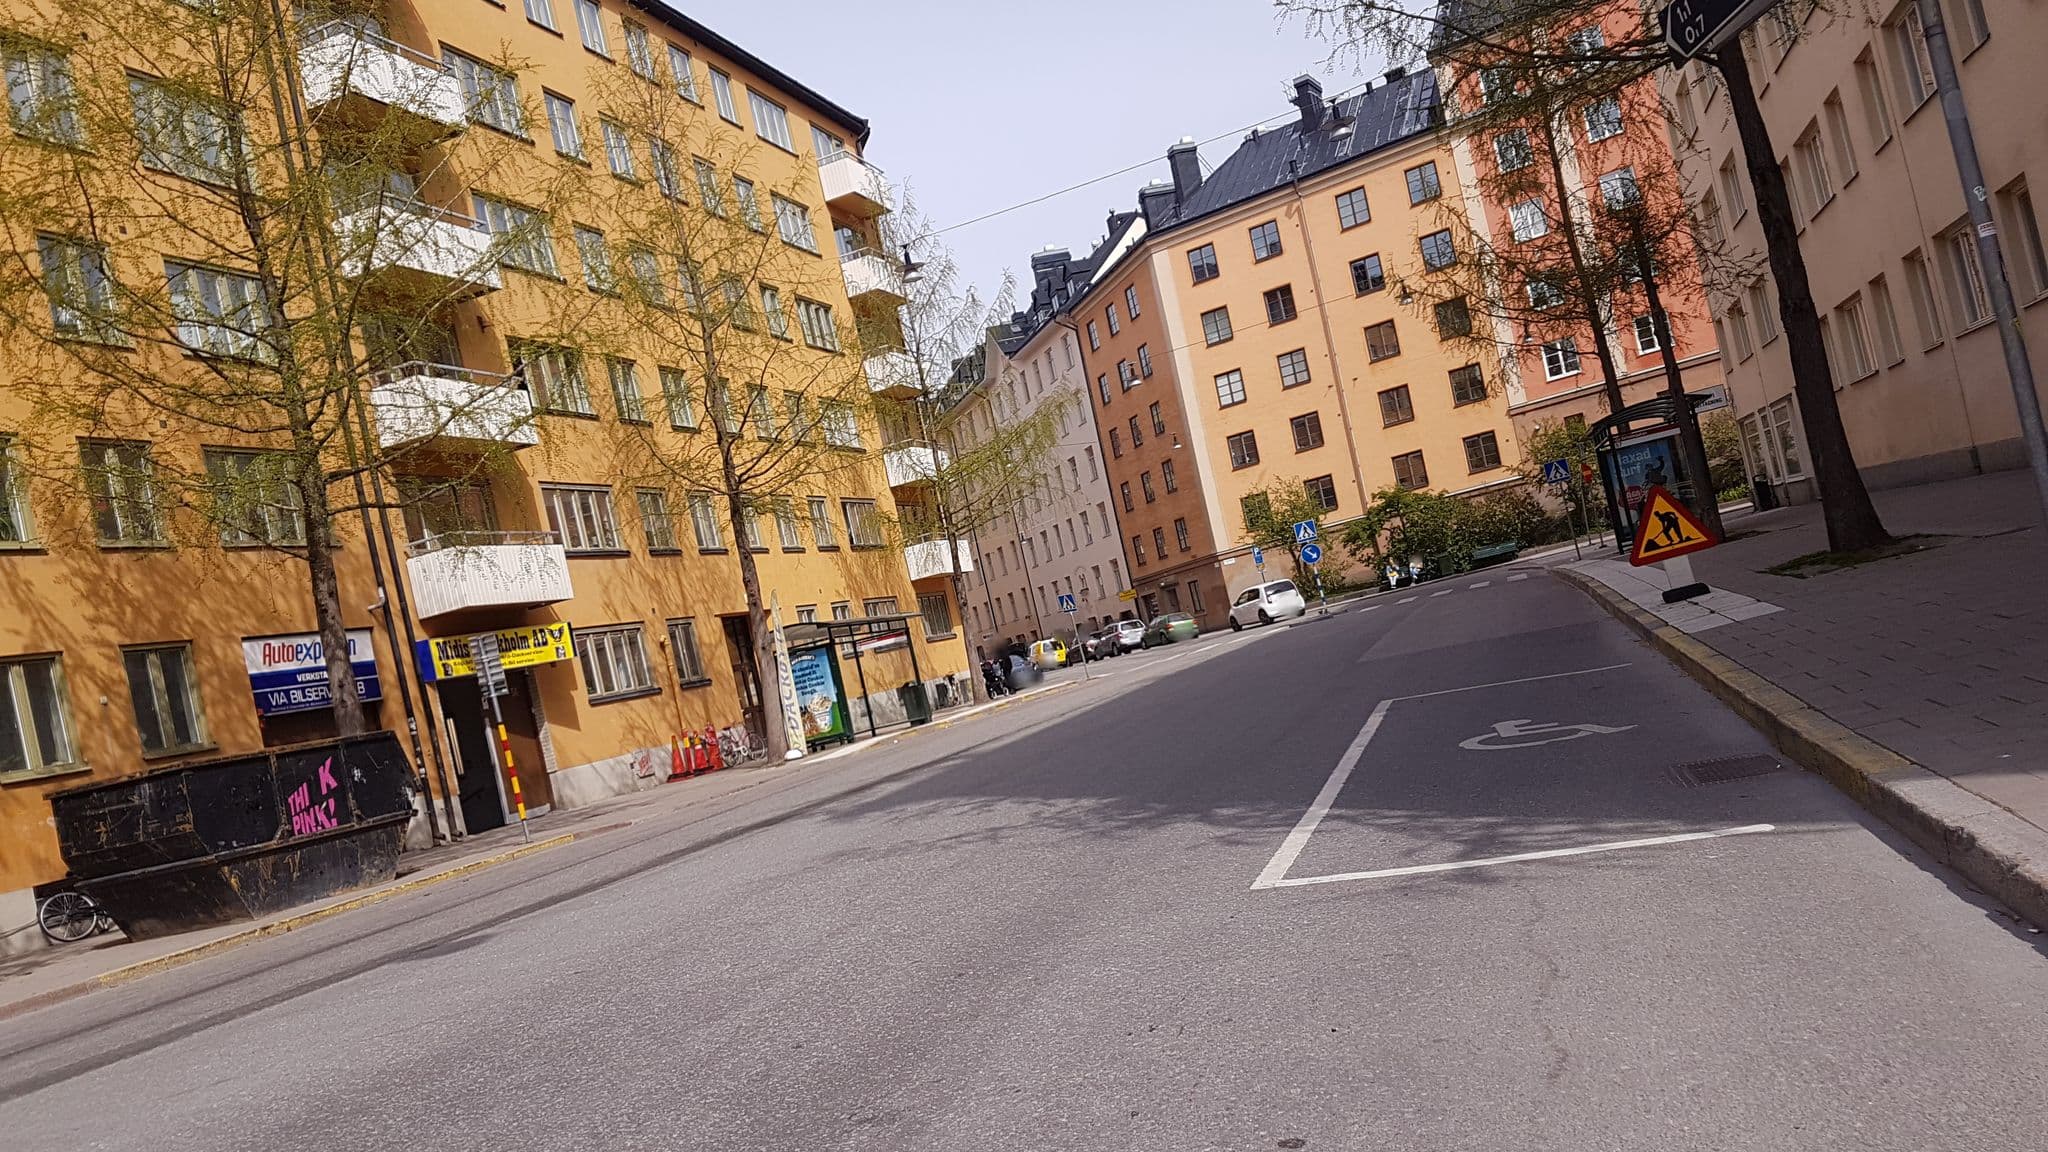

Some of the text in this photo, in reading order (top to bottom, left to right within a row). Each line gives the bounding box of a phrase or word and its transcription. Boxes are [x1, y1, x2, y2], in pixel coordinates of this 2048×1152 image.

[496, 631, 530, 653] kholm
[532, 628, 548, 648] AB
[263, 638, 356, 667] Autoexpn
[296, 671, 329, 682] VERKSTA
[268, 691, 288, 706] VIA
[290, 686, 332, 704] BILSERV
